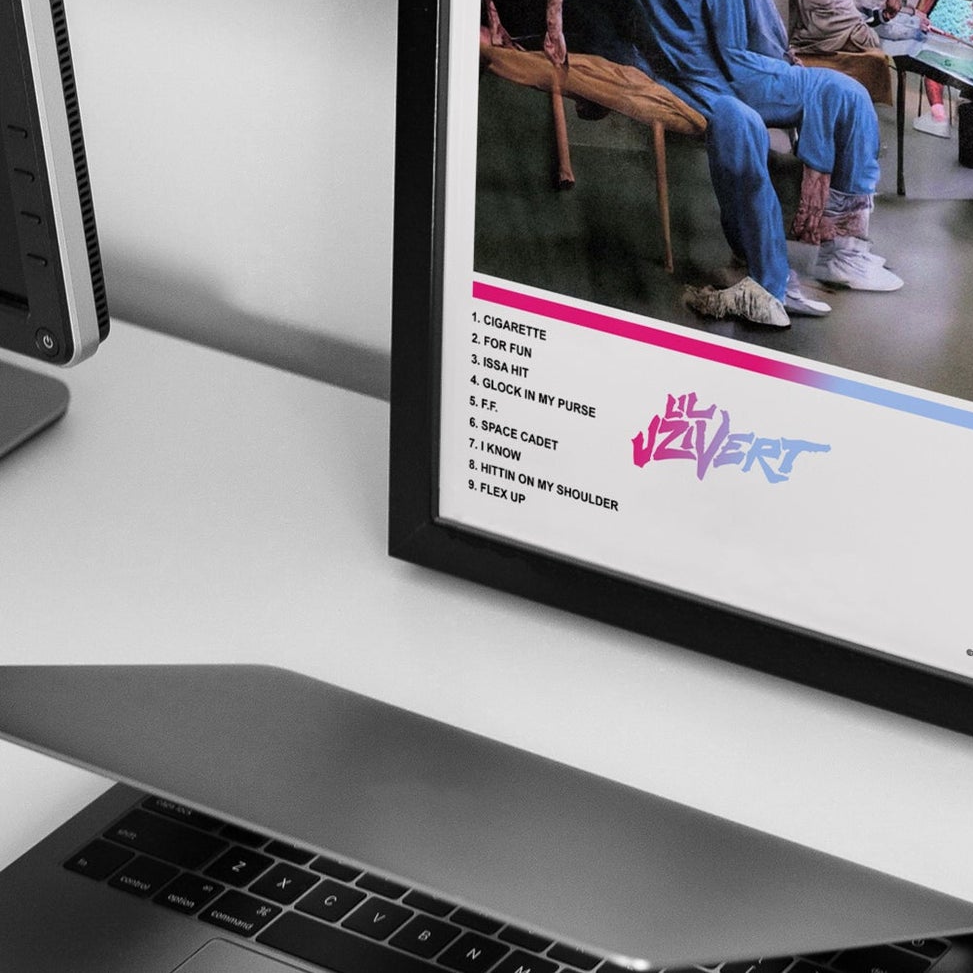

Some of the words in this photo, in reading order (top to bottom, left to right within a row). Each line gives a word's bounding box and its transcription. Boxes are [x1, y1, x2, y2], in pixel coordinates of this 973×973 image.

[472, 312, 480, 323] 1.
[483, 315, 546, 341] CIGARETTE
[472, 333, 480, 344] 2.
[484, 336, 506, 351] FOR
[509, 343, 532, 358] FUN
[471, 354, 480, 365] 3.
[483, 357, 509, 373] ISSA
[511, 364, 529, 378] HIT
[469, 395, 478, 407] 5.
[481, 398, 498, 412] F.F.
[470, 375, 479, 386] 4.
[482, 377, 522, 397] GLOCK
[524, 389, 535, 401] IN
[538, 393, 555, 406] MY
[558, 398, 596, 418] PURSE
[665, 392, 717, 420] LIL
[469, 417, 478, 428] 6.
[481, 420, 517, 440] SPACE
[520, 431, 558, 450] CADET
[469, 437, 478, 449] 7.
[481, 441, 484, 451] I
[487, 443, 521, 461] KNOW
[468, 479, 477, 491] 9.
[480, 482, 508, 500] FLEX
[510, 491, 526, 504] UP
[469, 459, 478, 470] 8.
[481, 462, 515, 481] HITTIN
[518, 473, 534, 487] ON
[537, 479, 554, 492] MY
[556, 484, 618, 511] SHOULDER
[232, 861, 246, 873] Z
[120, 875, 151, 892] control
[276, 878, 292, 889] X
[167, 893, 195, 910] option
[324, 895, 337, 906] C
[211, 909, 254, 931] command
[373, 912, 386, 923] V
[417, 929, 431, 942] B
[466, 947, 482, 960] N
